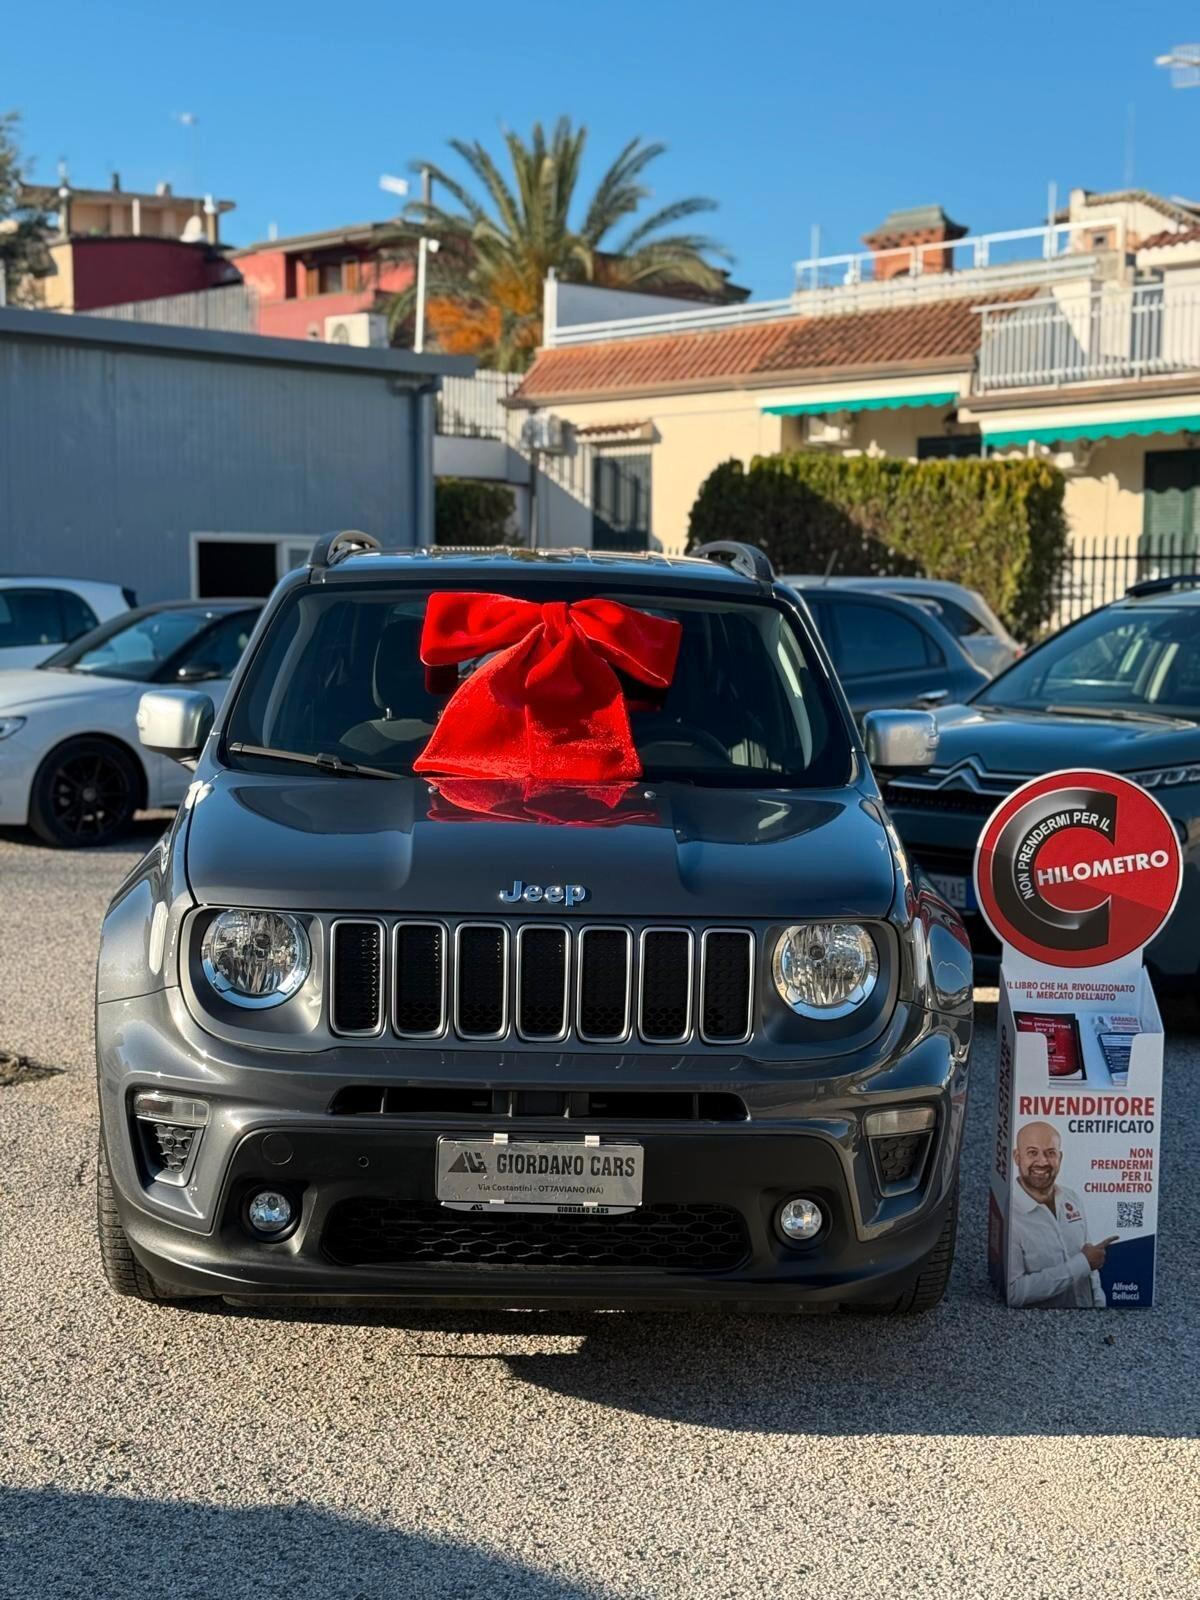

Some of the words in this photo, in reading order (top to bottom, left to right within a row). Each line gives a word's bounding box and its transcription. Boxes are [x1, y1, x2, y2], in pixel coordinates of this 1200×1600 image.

[1073, 811, 1099, 827] PER
[1100, 817, 1111, 832] IL
[1018, 813, 1070, 870] PRENDERMI
[1037, 850, 1169, 886] HILOMETRO
[1017, 872, 1035, 900] NON
[499, 880, 586, 906] Jeep
[1015, 982, 1038, 990] LIBRO
[1040, 982, 1055, 991] CHE
[1057, 983, 1068, 991] HA
[1072, 983, 1135, 993] RIVOLUZIONATO
[1026, 991, 1033, 999] IL
[1036, 991, 1073, 1000] MERCATO
[1075, 991, 1116, 1001] DELL'AUTO
[1019, 1096, 1155, 1117] RIVENDITORE
[1068, 1119, 1154, 1134] CERTIFICATO
[1129, 1148, 1153, 1159] NON
[496, 1153, 584, 1175] GIORDANO
[590, 1156, 635, 1177] CARS
[1091, 1159, 1153, 1170] PRENDERMI
[1121, 1171, 1142, 1182] PER
[1144, 1171, 1153, 1182] IL
[492, 1184, 532, 1192] Costantini
[538, 1185, 585, 1193] OTTAVIANO
[586, 1186, 604, 1194] (NA)
[1084, 1182, 1152, 1193] CHILOMETRO
[557, 1206, 590, 1214] GIORDANO
[1112, 1282, 1138, 1291] Alfredo
